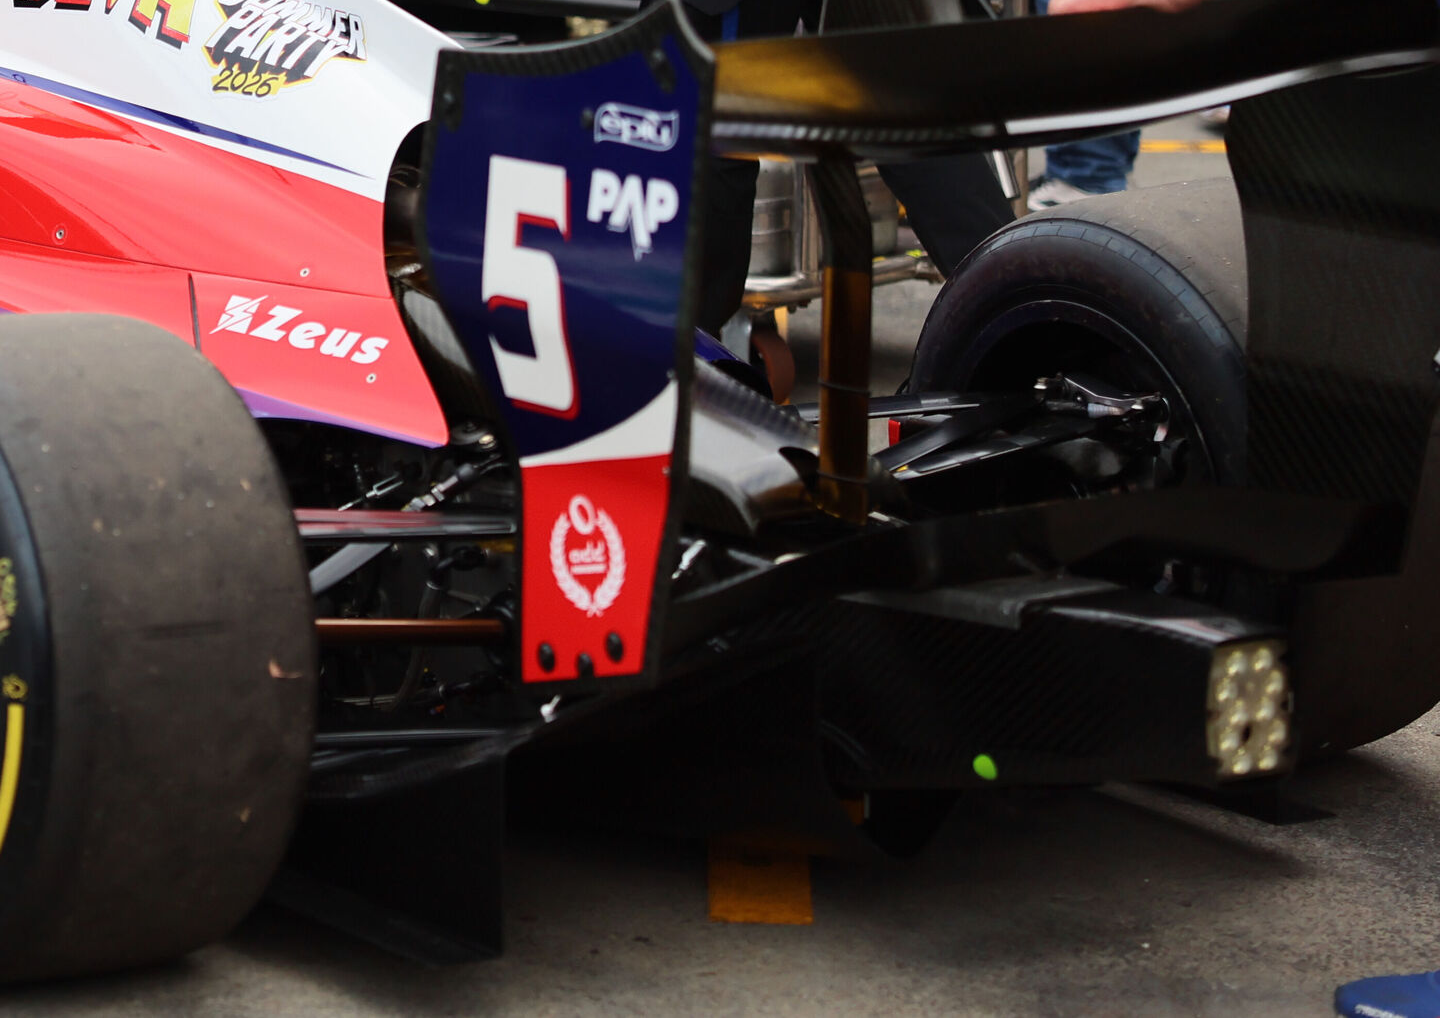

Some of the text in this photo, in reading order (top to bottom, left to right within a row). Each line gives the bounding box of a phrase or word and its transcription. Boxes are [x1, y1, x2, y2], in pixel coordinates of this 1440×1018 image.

[204, 3, 350, 78] PARTY
[212, 69, 279, 98] 2026
[481, 154, 578, 420] 5
[250, 304, 390, 365] Zeus
